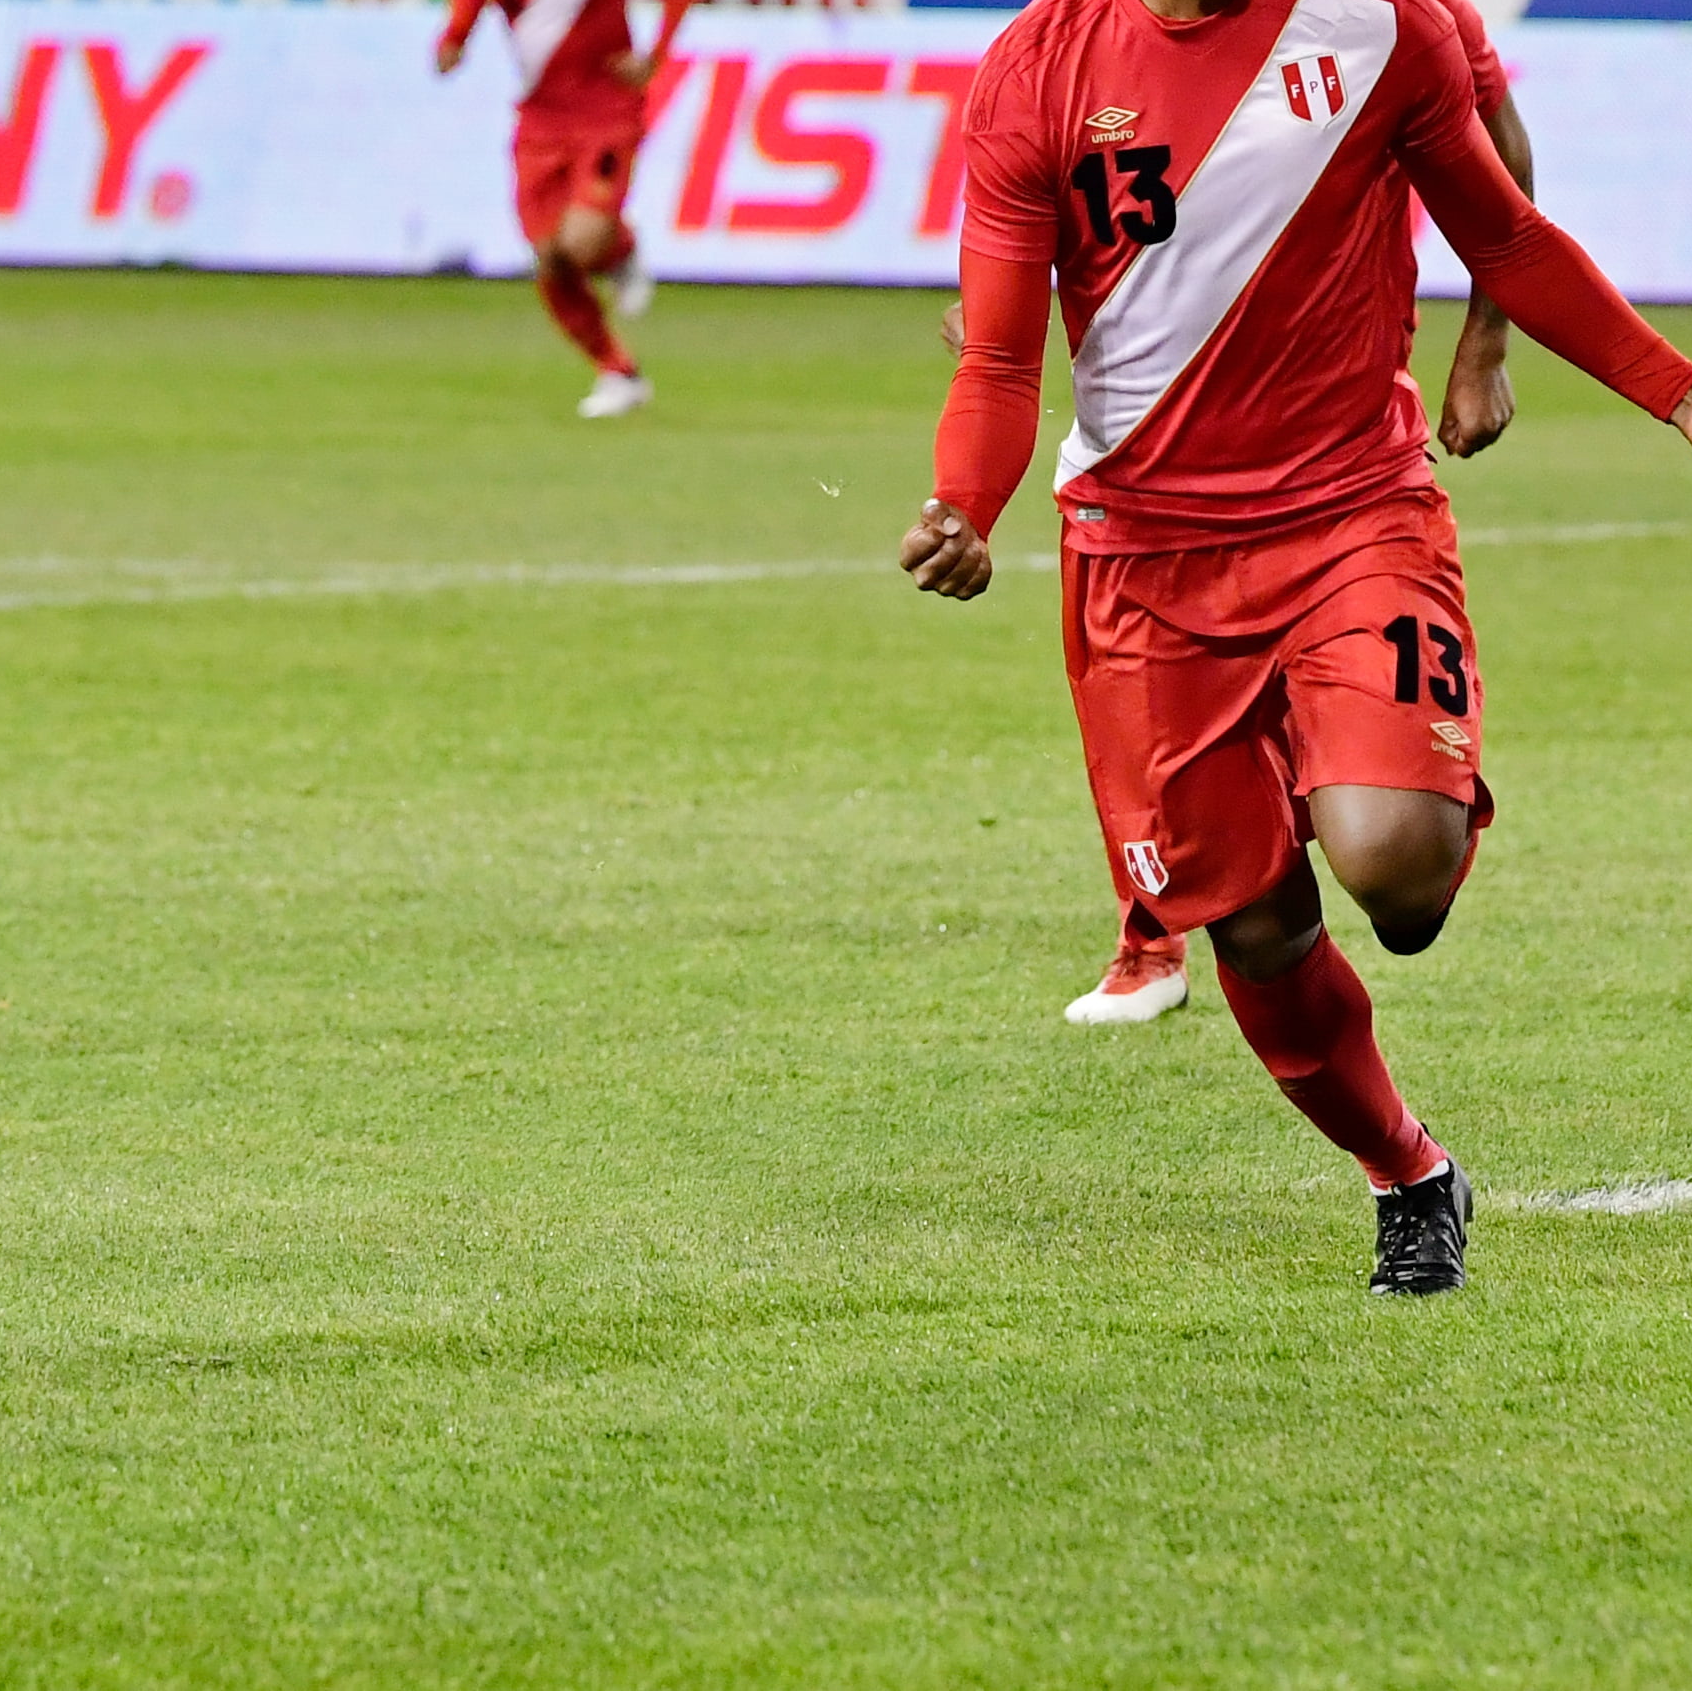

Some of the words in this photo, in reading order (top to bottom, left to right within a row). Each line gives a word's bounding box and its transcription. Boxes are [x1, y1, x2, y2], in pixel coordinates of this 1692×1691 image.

[1091, 129, 1135, 144] umbro
[1071, 144, 1177, 246] 13
[1382, 615, 1469, 717] 13
